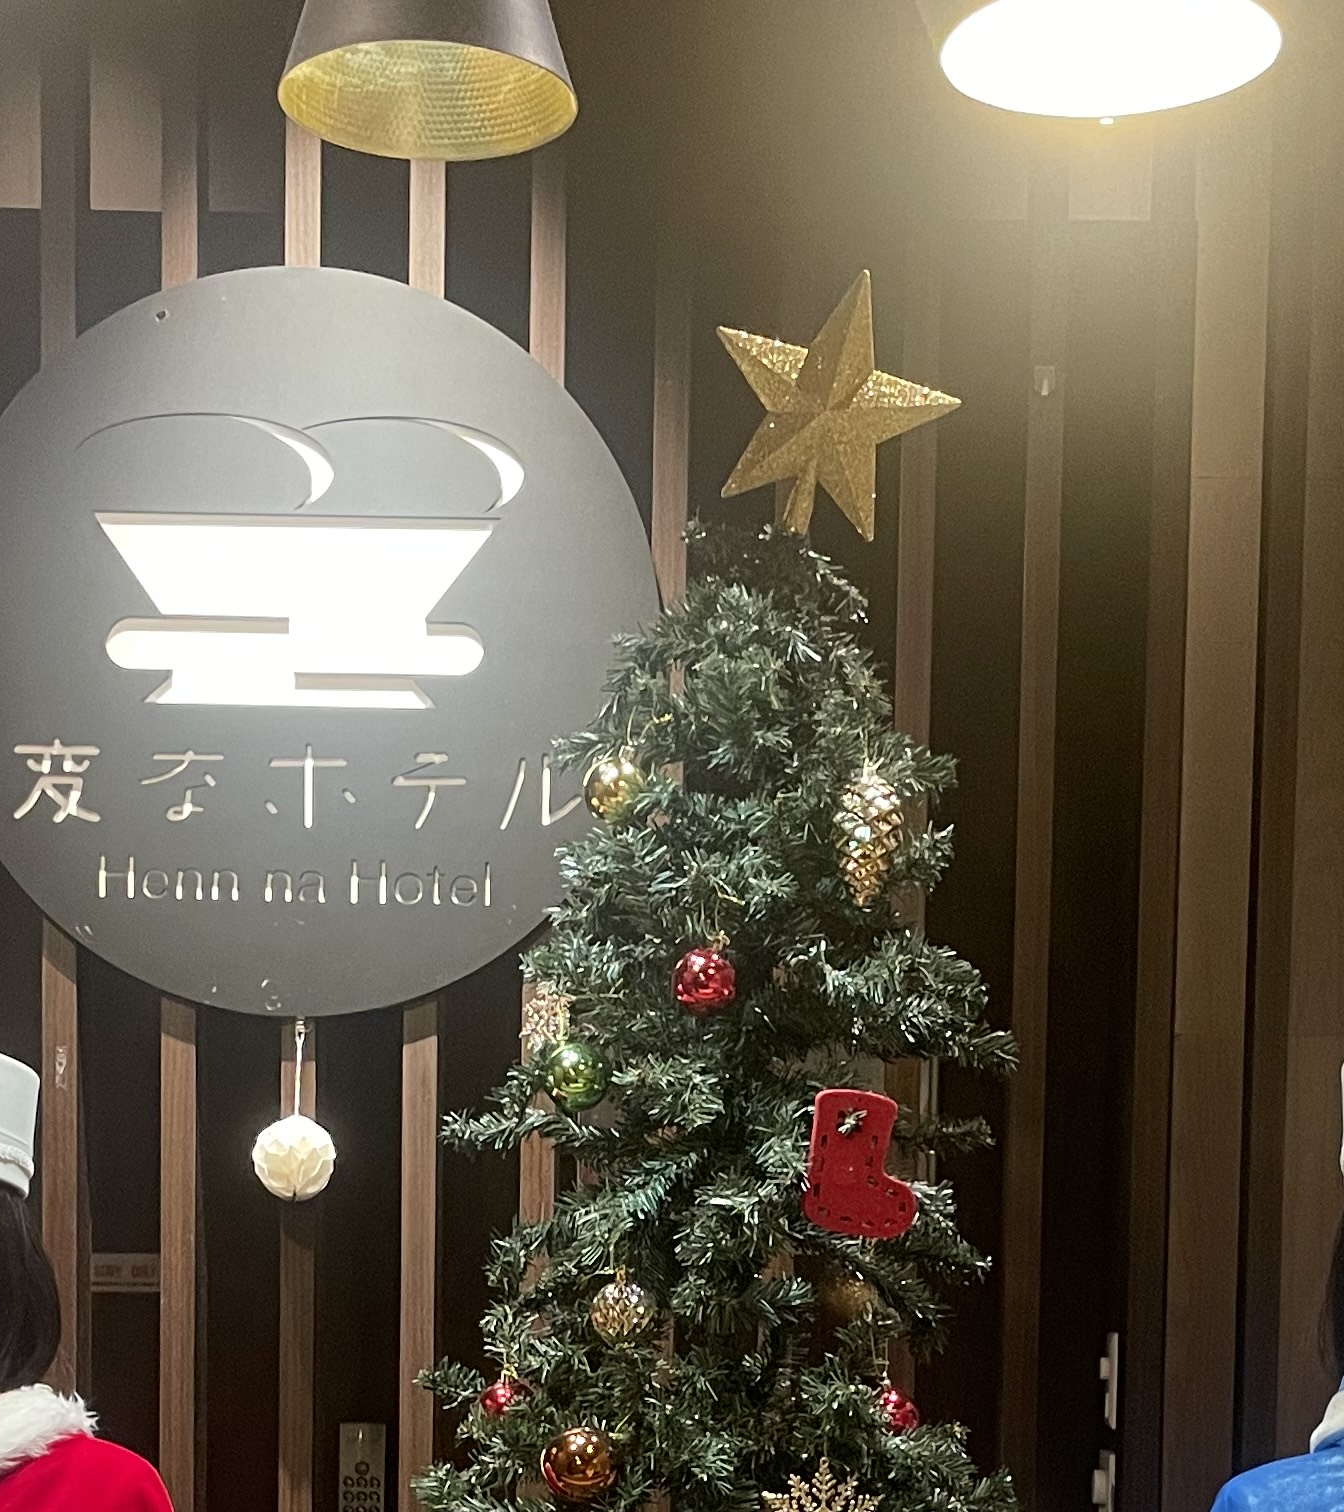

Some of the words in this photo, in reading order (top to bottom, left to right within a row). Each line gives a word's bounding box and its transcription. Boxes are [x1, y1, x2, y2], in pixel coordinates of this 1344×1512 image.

[13, 739, 584, 830] 変なホテル
[97, 856, 239, 902] Henn
[264, 866, 326, 904] na
[348, 860, 494, 908] Hotel
